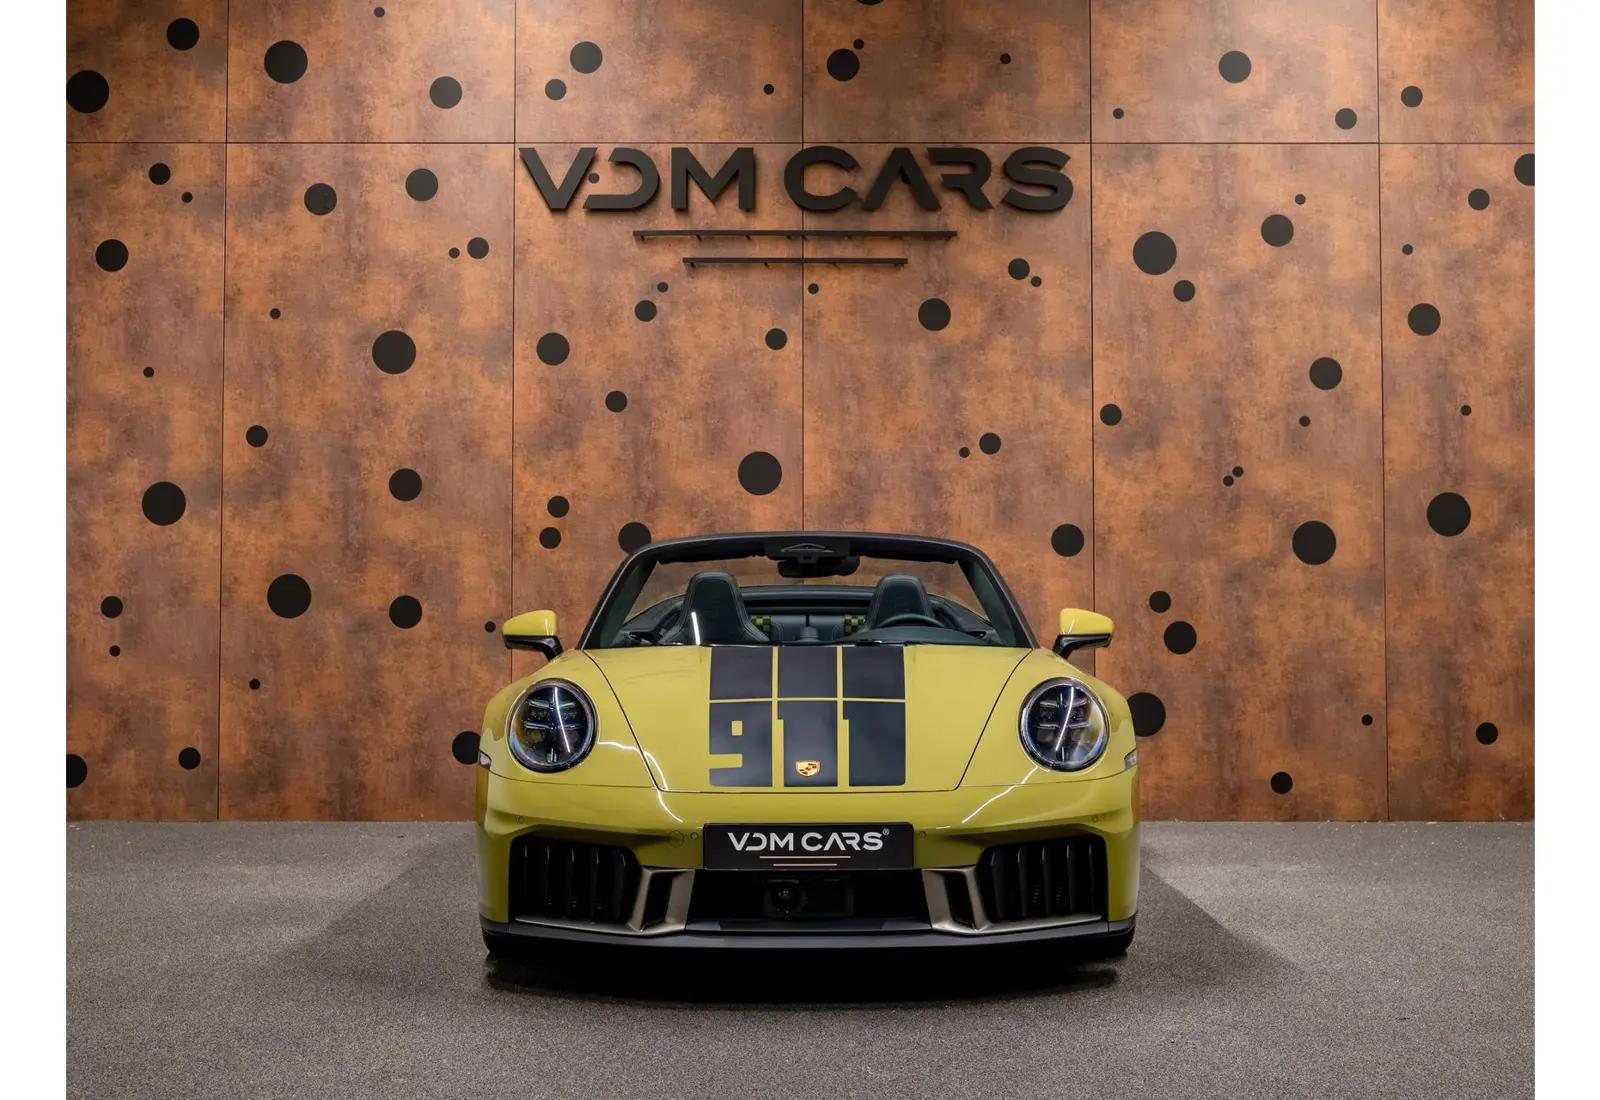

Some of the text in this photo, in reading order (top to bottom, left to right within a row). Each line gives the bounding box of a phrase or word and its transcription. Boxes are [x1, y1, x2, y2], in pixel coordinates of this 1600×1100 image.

[518, 145, 1075, 212] VDM CARS
[709, 700, 906, 787] 911
[727, 832, 794, 852] VDM
